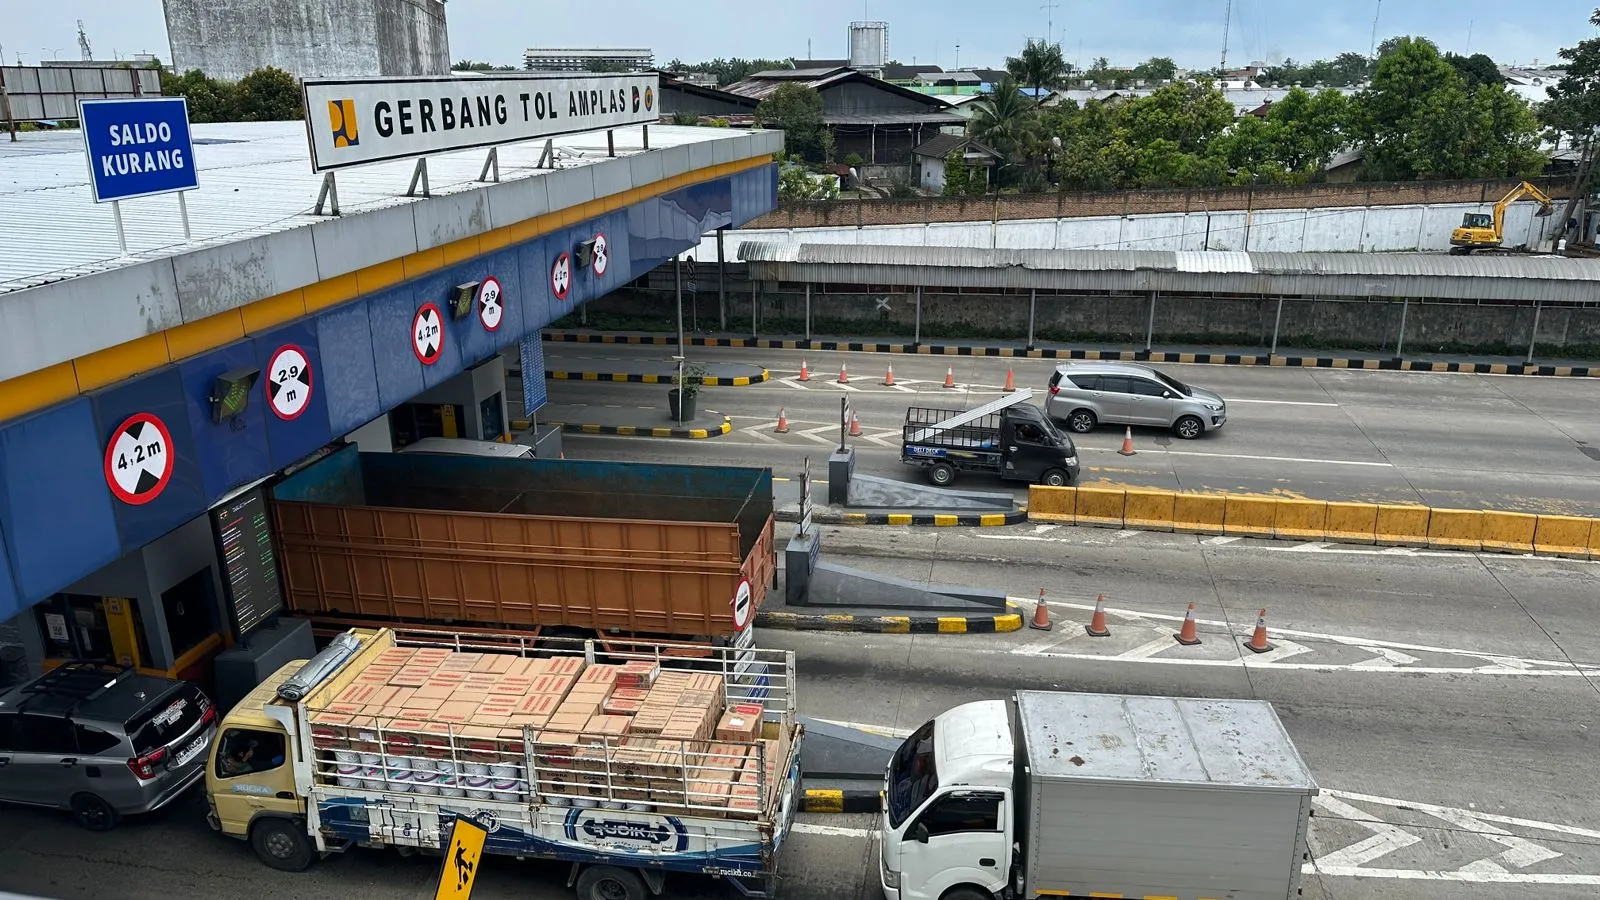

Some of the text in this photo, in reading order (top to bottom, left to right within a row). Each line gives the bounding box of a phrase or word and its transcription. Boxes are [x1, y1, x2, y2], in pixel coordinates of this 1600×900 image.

[374, 88, 626, 138] GERBANG TOL AMPLAS
[109, 121, 172, 146] SALDO
[101, 148, 184, 177] KURANG
[488, 306, 495, 315] m
[278, 365, 299, 384] 2,9
[286, 388, 297, 402] m
